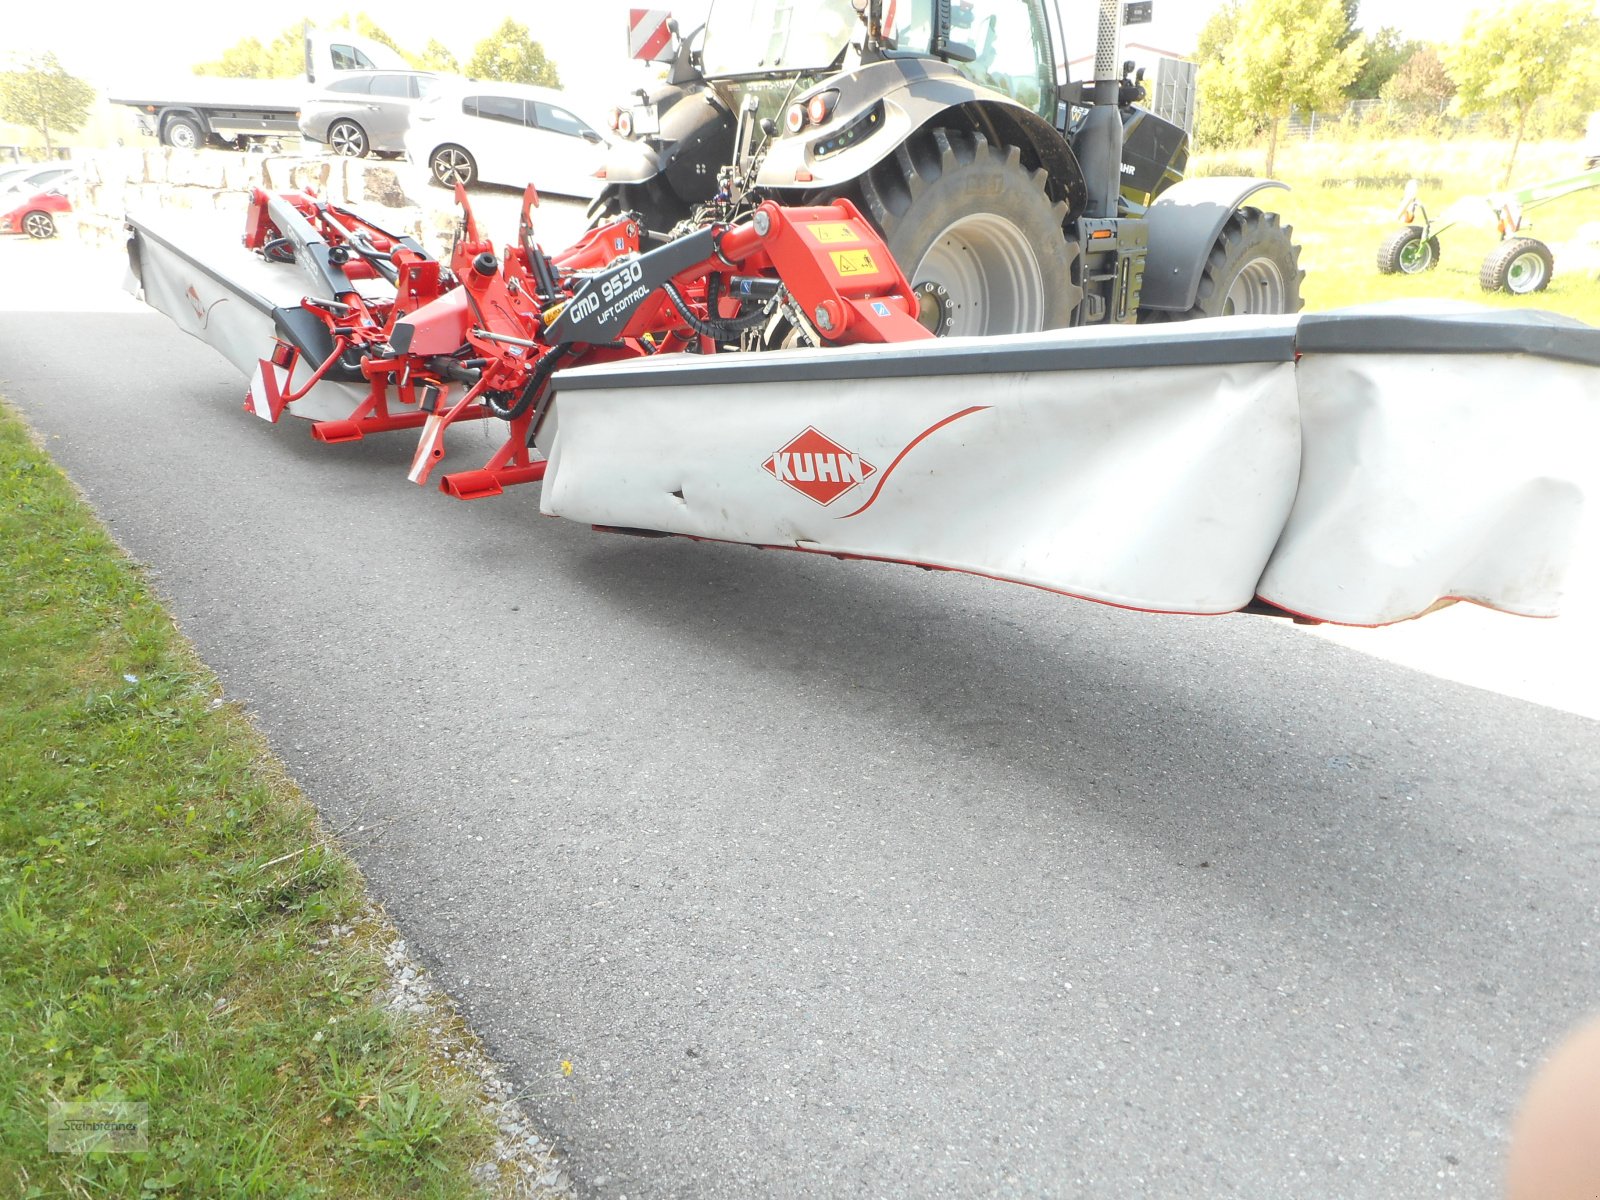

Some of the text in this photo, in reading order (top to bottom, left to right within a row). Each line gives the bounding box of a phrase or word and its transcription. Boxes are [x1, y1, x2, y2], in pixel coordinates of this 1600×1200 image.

[569, 291, 600, 324] GMD
[601, 260, 643, 303] 9530
[597, 284, 650, 325] LIFT CONTROL
[772, 451, 865, 484] KUHN
